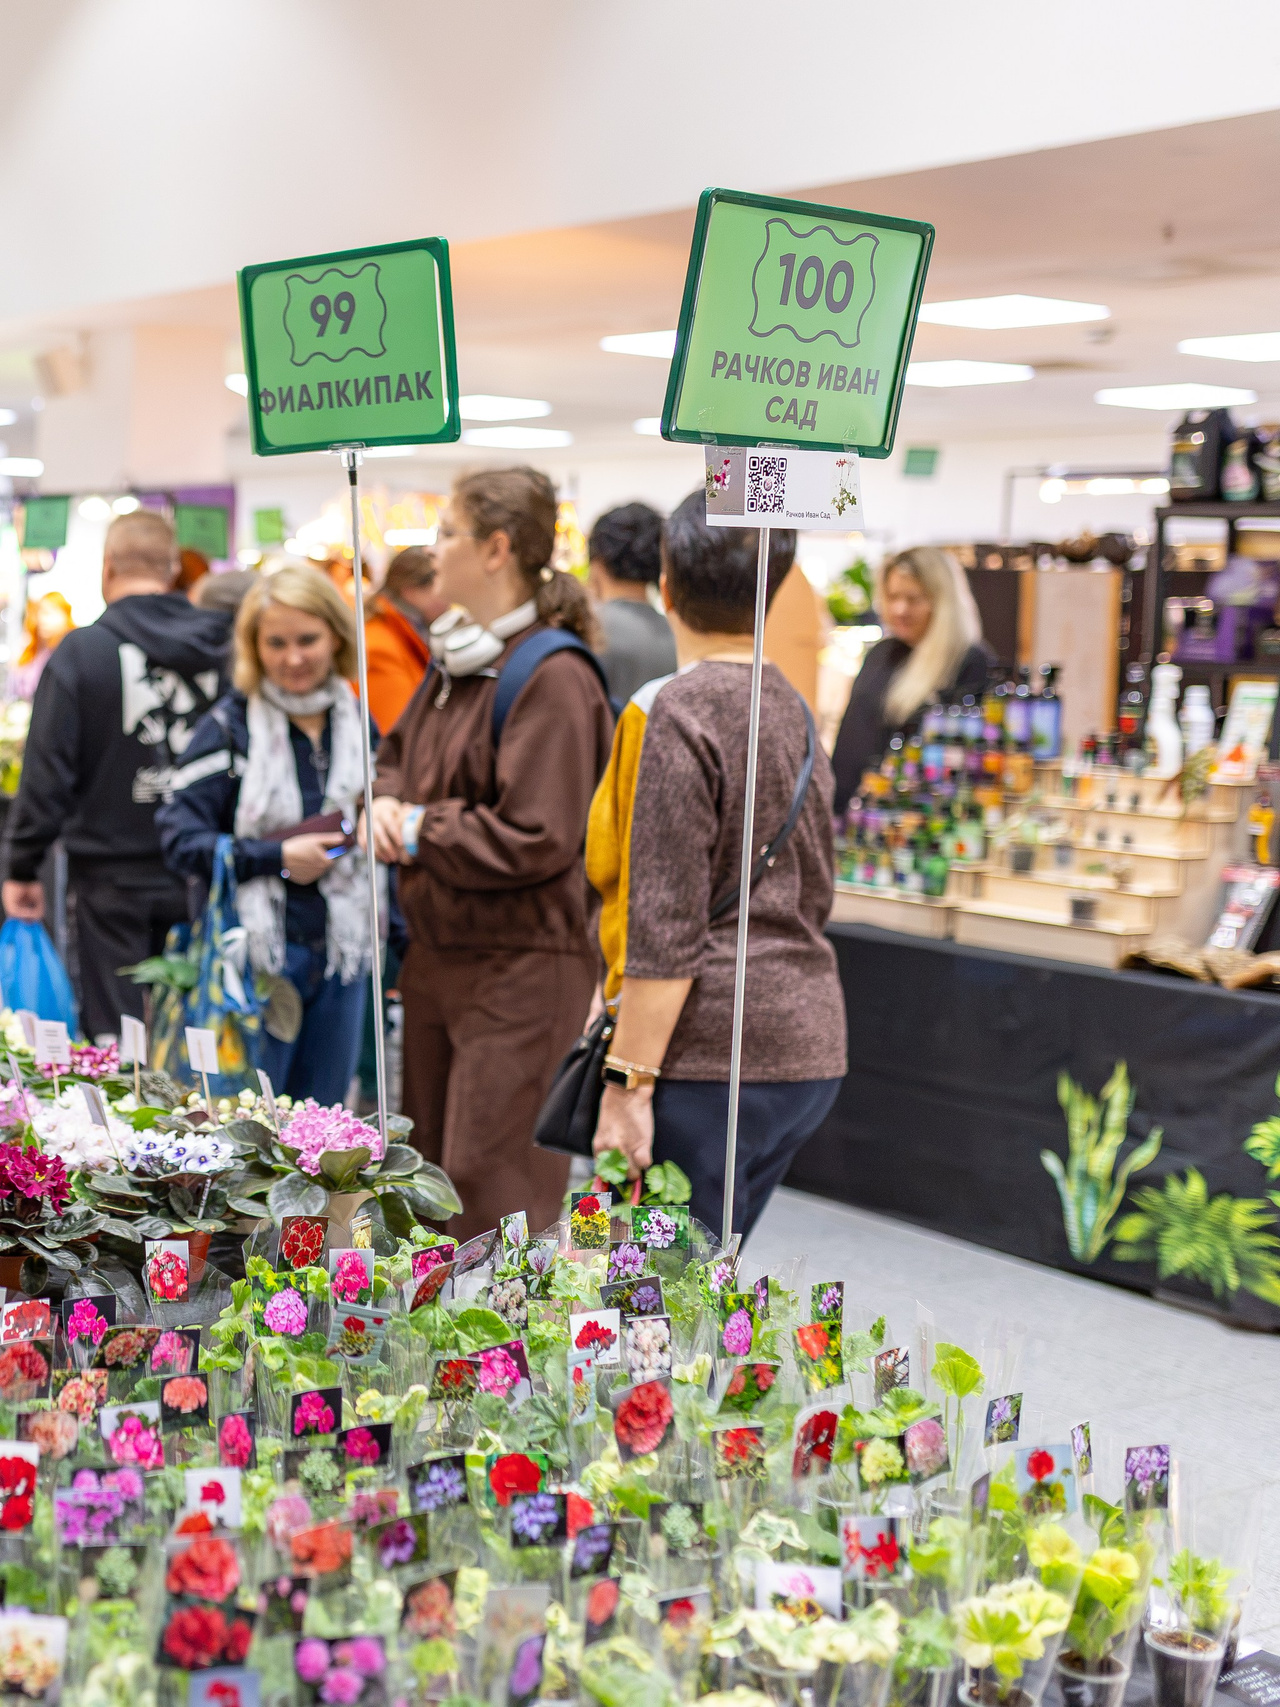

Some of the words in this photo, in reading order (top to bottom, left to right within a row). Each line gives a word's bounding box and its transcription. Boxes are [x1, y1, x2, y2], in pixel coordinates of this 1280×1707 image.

[779, 253, 855, 314] 100
[310, 290, 356, 338] 99
[258, 370, 434, 416] ФИАЛКИПАК
[711, 350, 812, 388] РАЧКОВ
[816, 362, 880, 396] ИВАН
[765, 395, 819, 431] САД
[785, 510, 805, 518] Рачков
[806, 511, 819, 519] Иван
[820, 511, 831, 520] Сад
